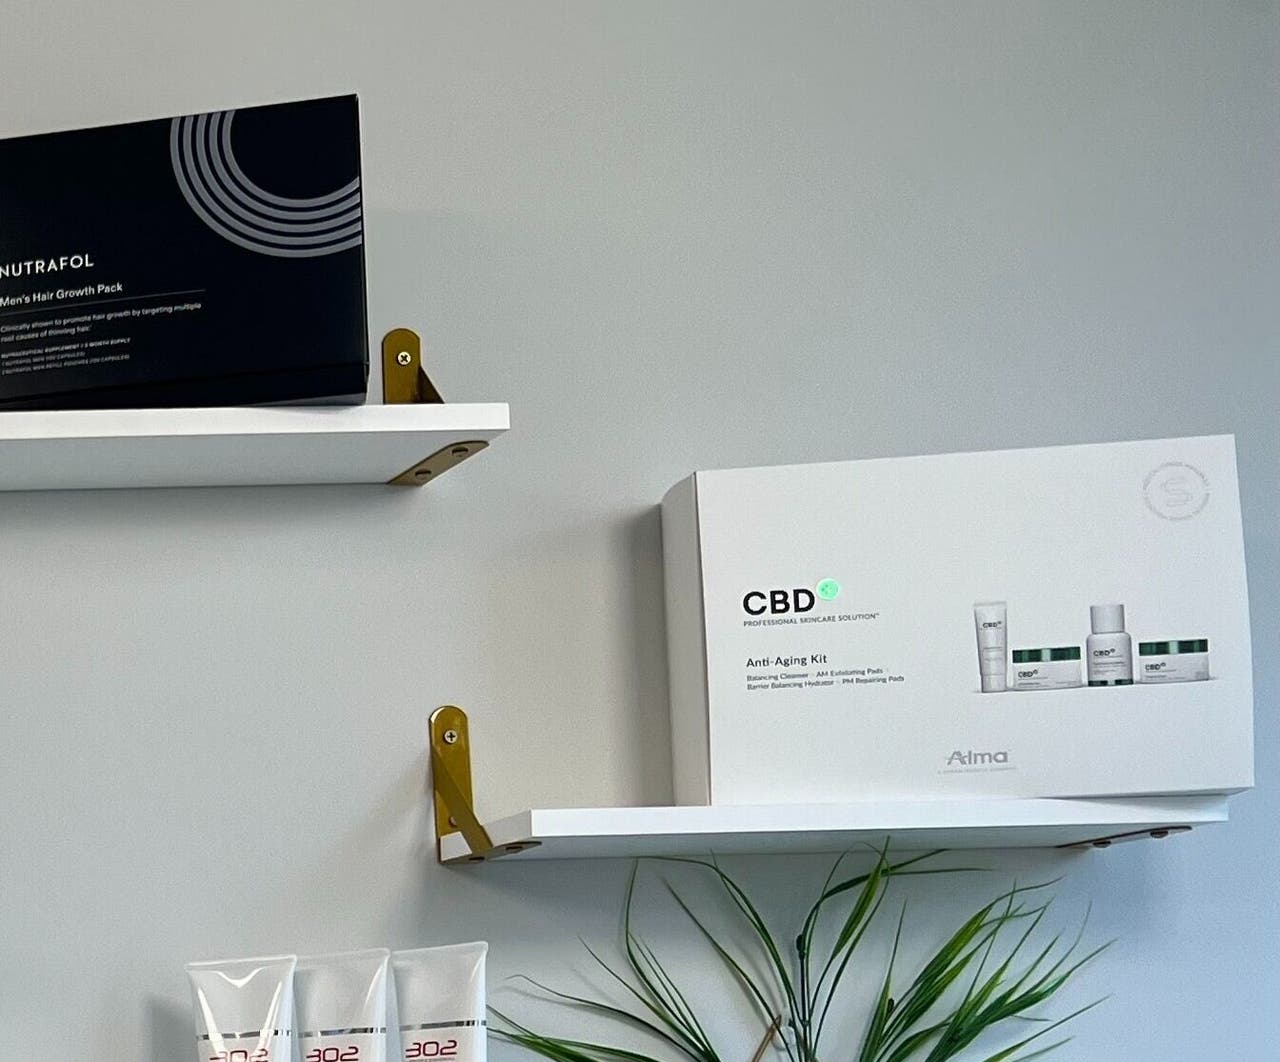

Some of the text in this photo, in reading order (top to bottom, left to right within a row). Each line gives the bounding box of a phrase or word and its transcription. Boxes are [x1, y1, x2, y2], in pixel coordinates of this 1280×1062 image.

[0, 281, 123, 308] Men's Hair Growth Pack
[743, 588, 815, 616] CBD
[743, 618, 798, 627] PROFESSIONAL
[800, 615, 836, 624] SKINCARE
[746, 654, 827, 668] Anti-Aging Kit
[746, 673, 778, 682] Balancing
[867, 667, 883, 675] Pads
[747, 683, 769, 691] Barrier
[771, 681, 803, 690] Balancing
[947, 750, 1008, 766] Alma
[405, 1040, 457, 1058] 302
